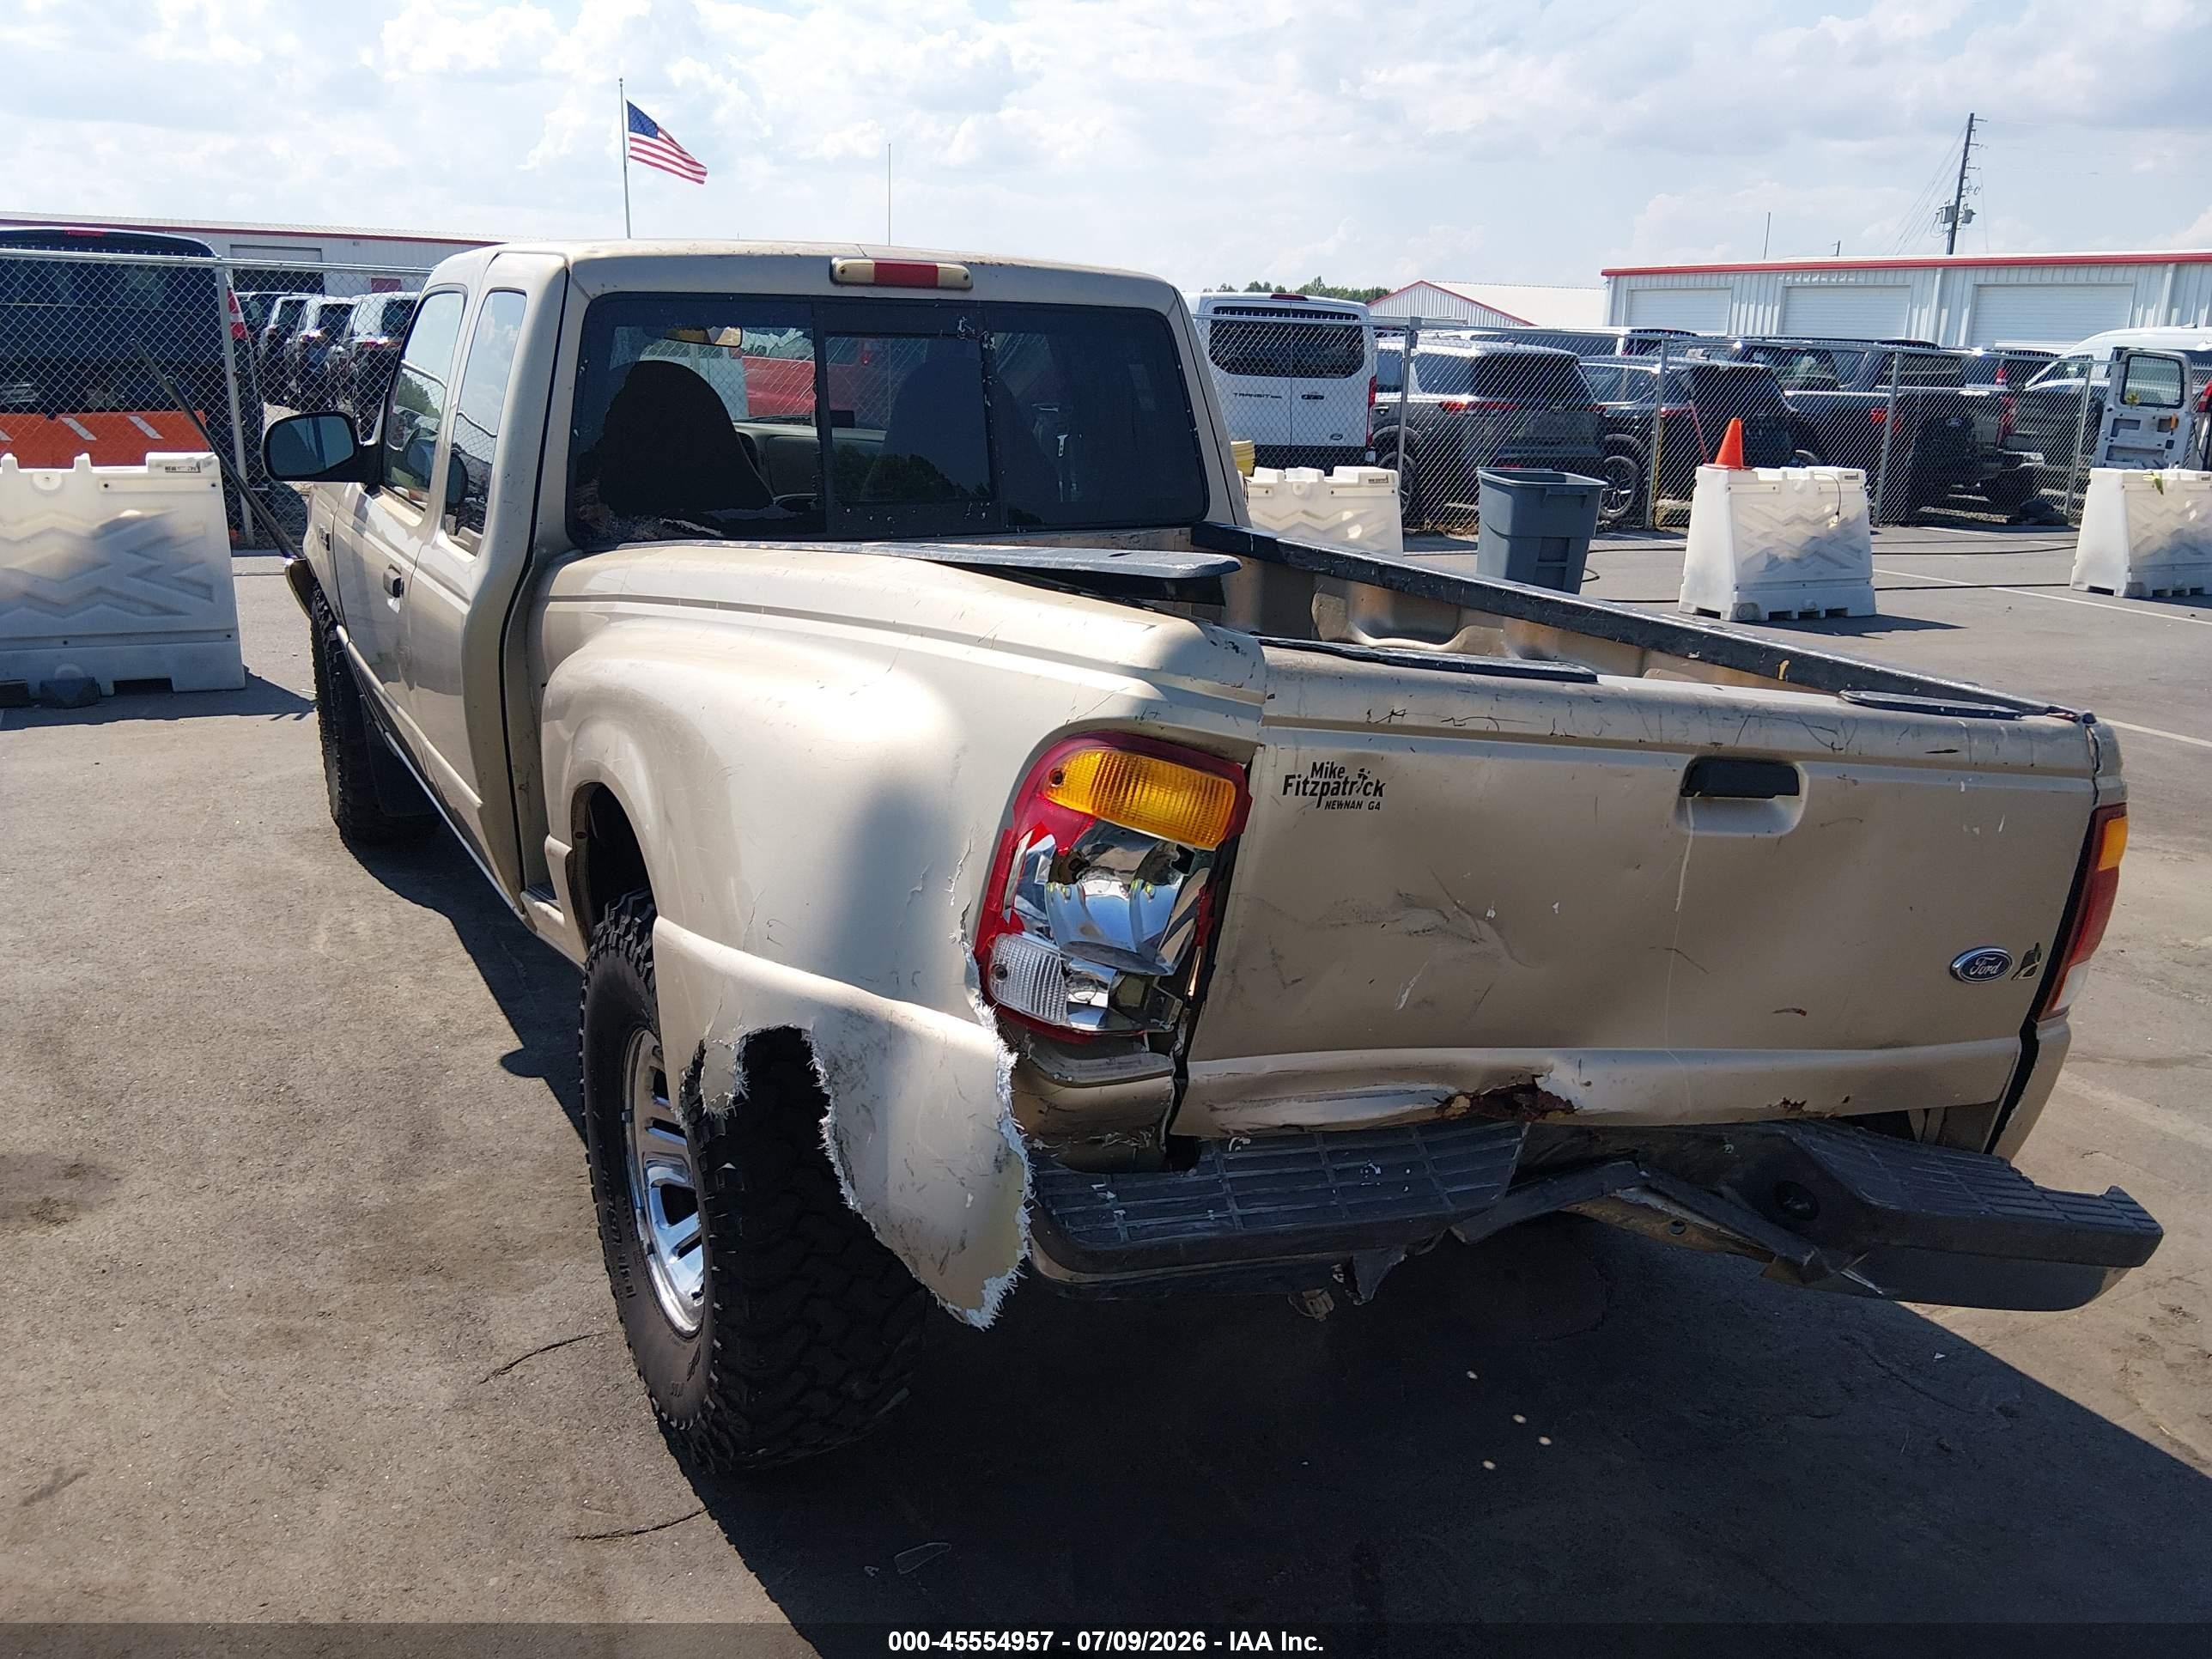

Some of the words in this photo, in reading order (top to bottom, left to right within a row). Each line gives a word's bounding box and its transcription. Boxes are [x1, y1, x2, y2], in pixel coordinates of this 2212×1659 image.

[1310, 761, 1346, 780] Mike
[1324, 799, 1363, 810] NEWNAN
[1970, 957, 2003, 975] Ford
